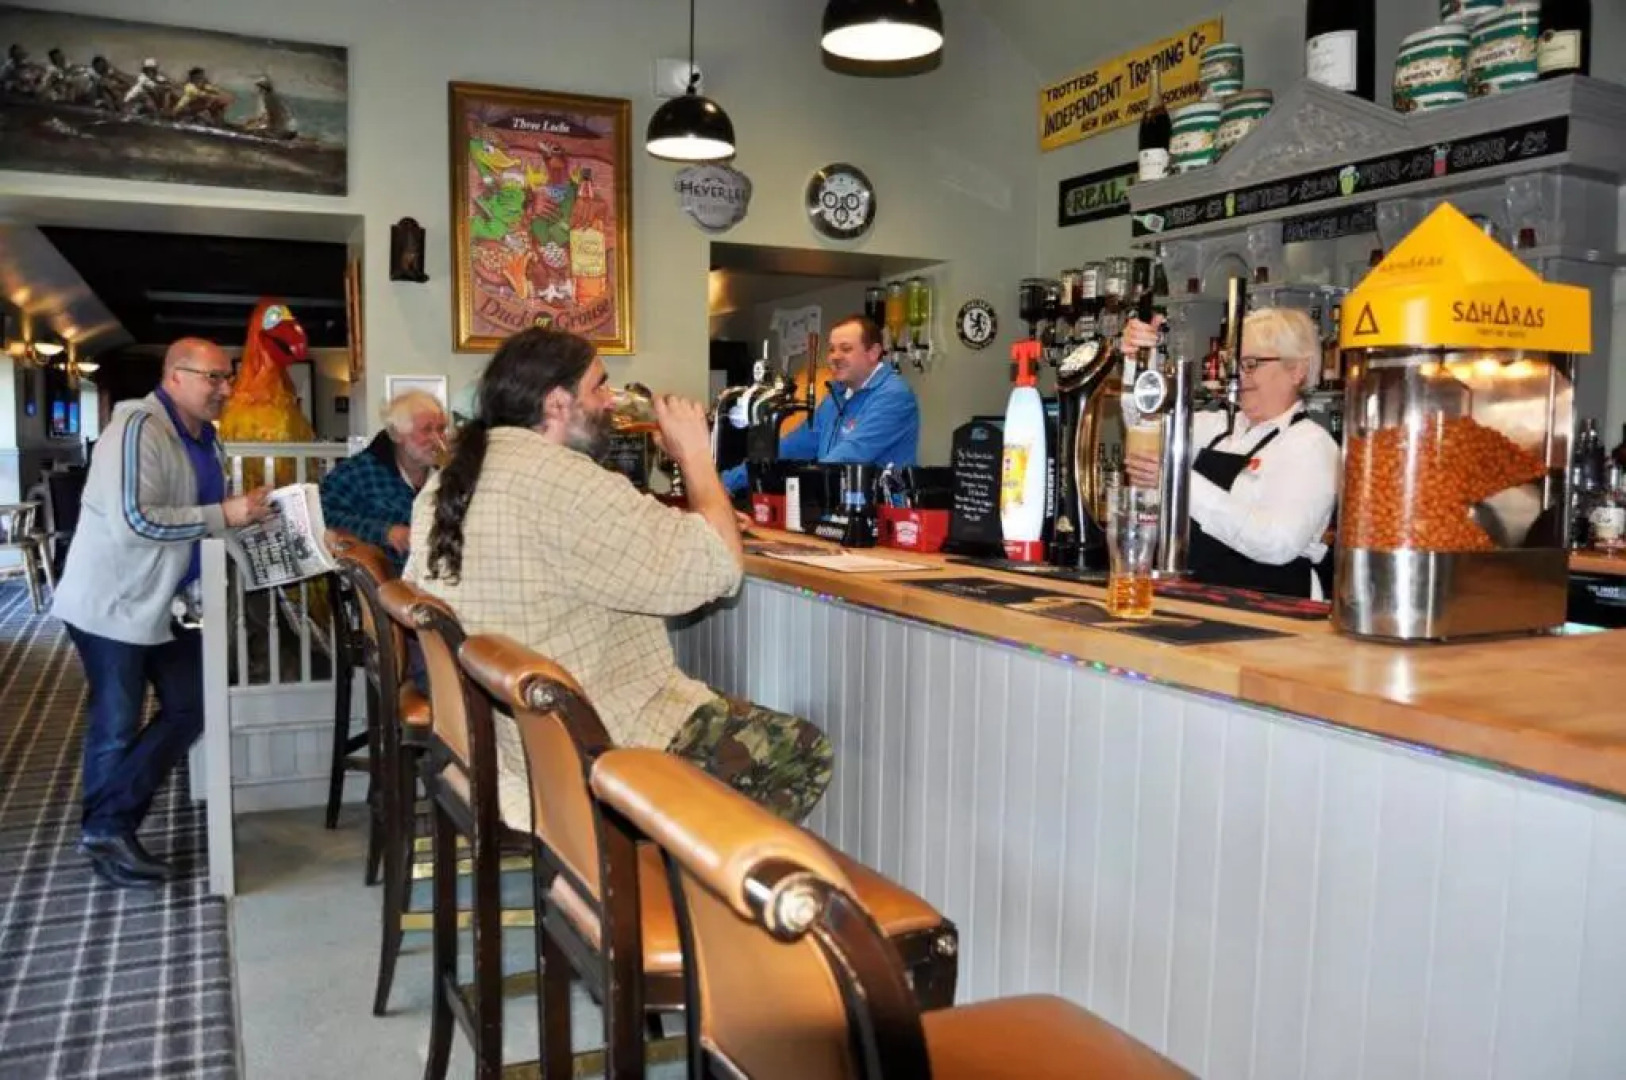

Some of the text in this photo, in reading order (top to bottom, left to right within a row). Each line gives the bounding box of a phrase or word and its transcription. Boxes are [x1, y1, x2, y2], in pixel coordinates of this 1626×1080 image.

[1043, 75, 1124, 138] INDEPENDENT
[1126, 40, 1185, 91] TRADING
[1045, 70, 1100, 103] TROTTERS
[1403, 67, 1443, 83] WHISKY
[512, 116, 541, 131] Three
[480, 297, 529, 326] Duck
[555, 297, 611, 328] Grouse
[1452, 297, 1545, 329] SAHARAS
